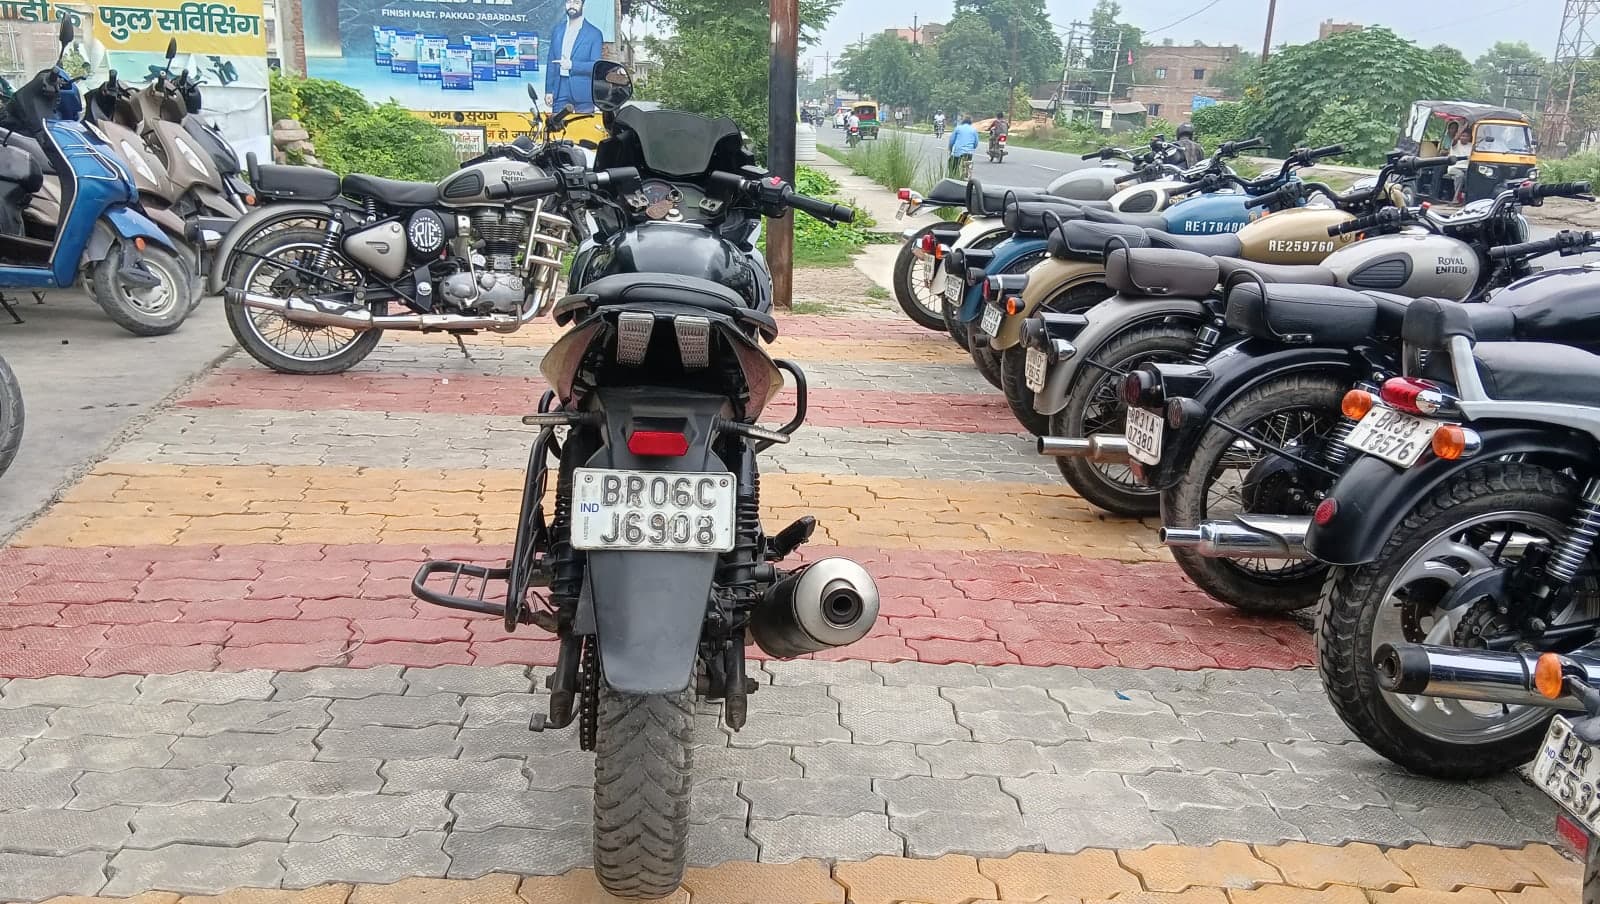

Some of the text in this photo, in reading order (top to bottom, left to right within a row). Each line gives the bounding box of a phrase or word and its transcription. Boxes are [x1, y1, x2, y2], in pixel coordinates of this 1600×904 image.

[100, 7, 152, 40] फुल
[156, 3, 260, 35] सर्विसिंग
[382, 8, 529, 22] FINISH MAST. PAKKAD JABARDAST.
[1269, 239, 1334, 252] RE259760
[1435, 265, 1468, 275] ENFIELD
[1438, 256, 1465, 266] ROYAL
[1375, 411, 1420, 438] BR33
[1361, 429, 1414, 460] T3576
[602, 474, 716, 509] BR06C
[580, 503, 600, 513] IND
[600, 511, 715, 545] J6908
